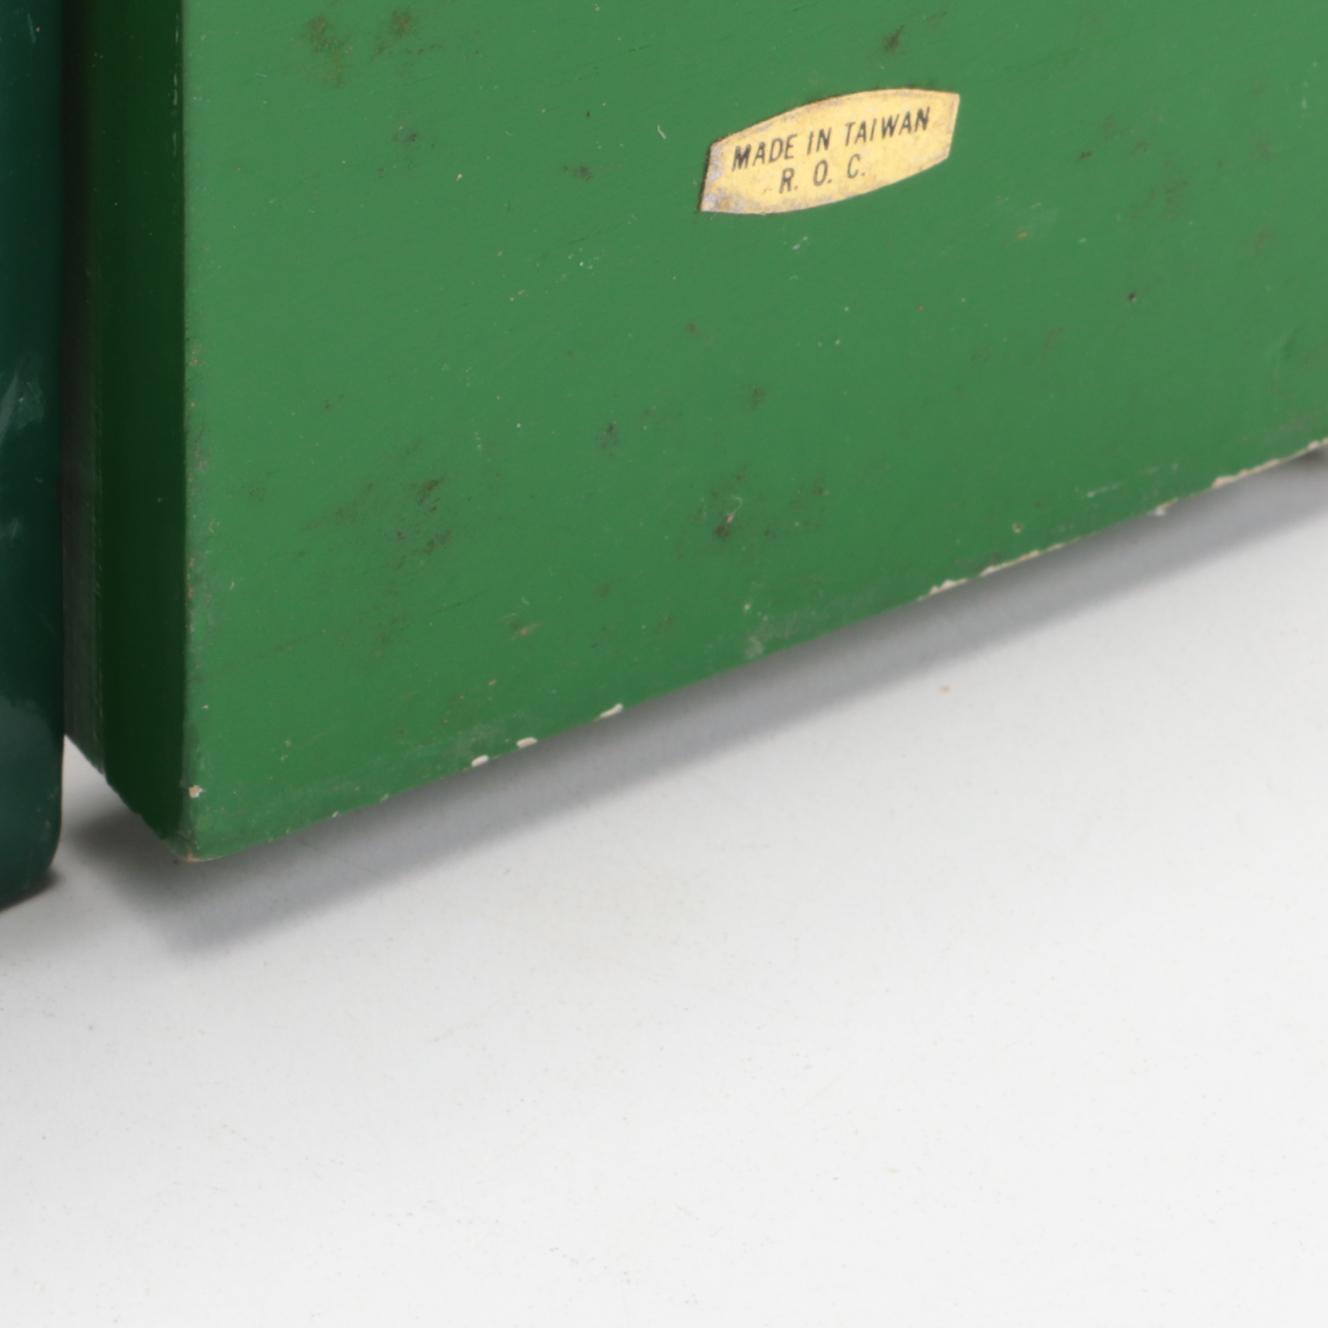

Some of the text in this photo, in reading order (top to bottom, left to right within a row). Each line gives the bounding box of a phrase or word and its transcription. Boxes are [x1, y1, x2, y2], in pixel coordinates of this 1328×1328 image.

[732, 106, 931, 172] MADE IN TAIWAN
